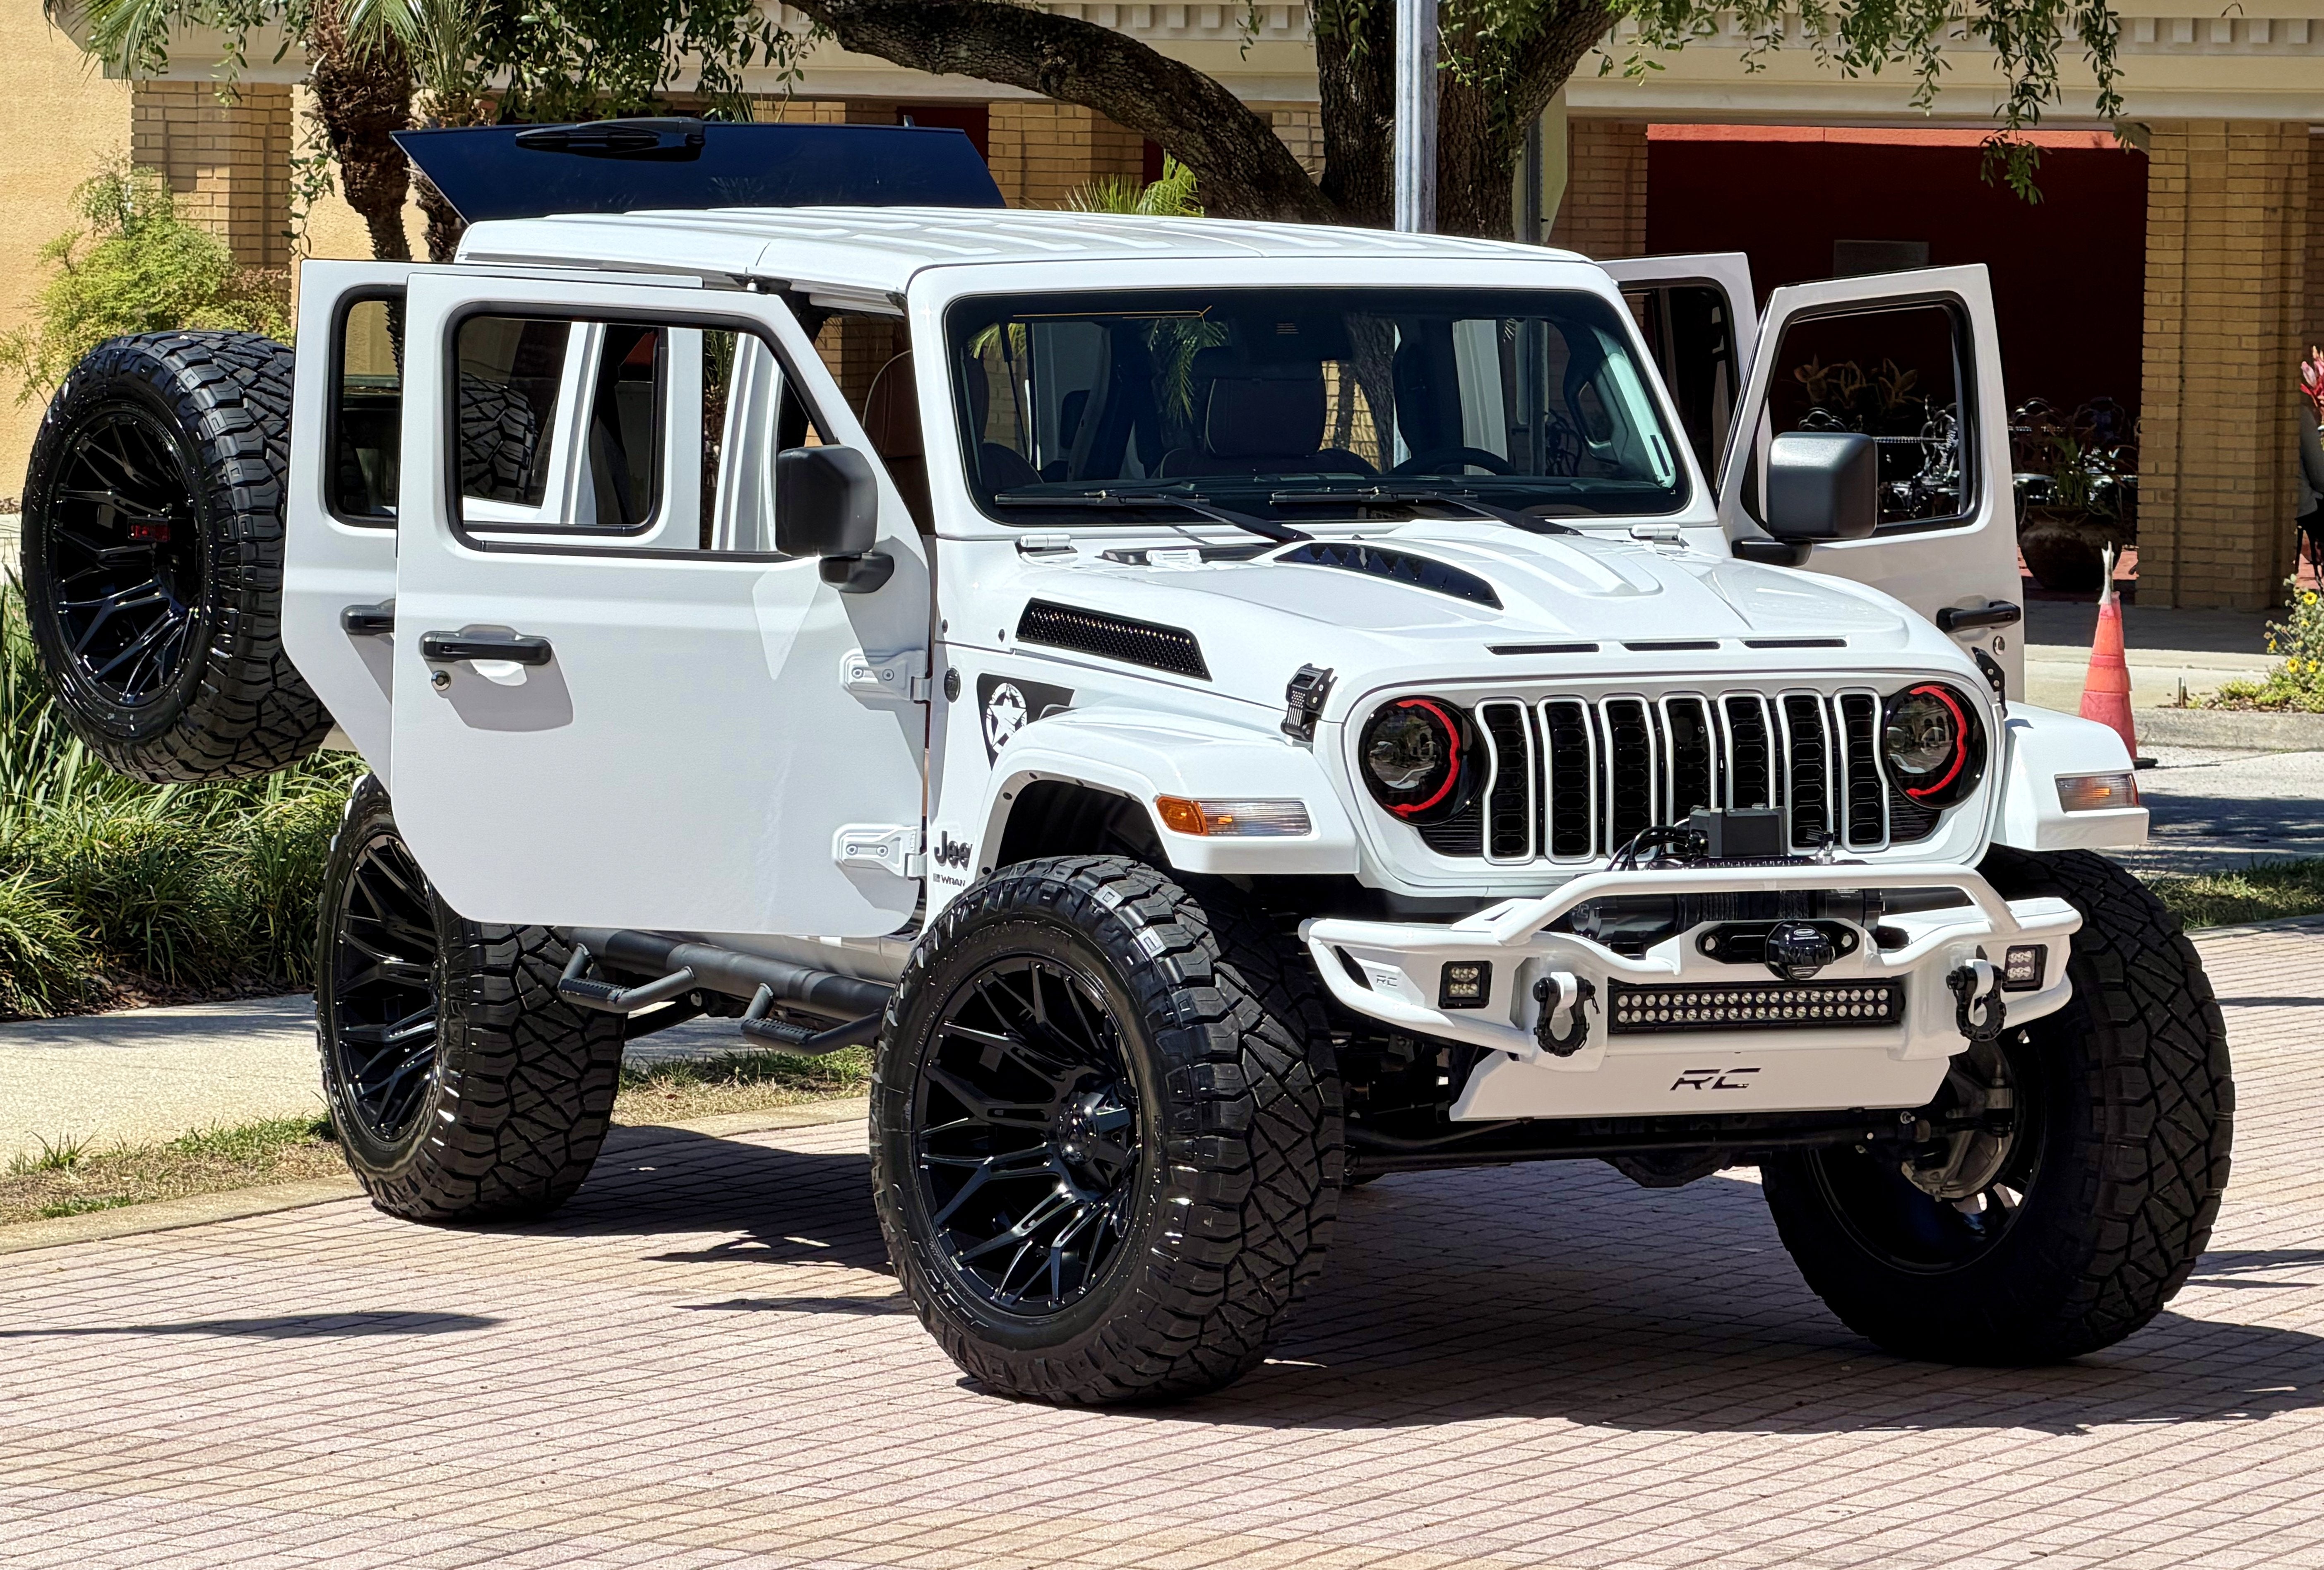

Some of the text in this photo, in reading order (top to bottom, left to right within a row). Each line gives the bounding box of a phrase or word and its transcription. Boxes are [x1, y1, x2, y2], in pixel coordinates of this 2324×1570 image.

[934, 830, 973, 871] Jee
[1376, 975, 1397, 987] RC
[1670, 1068, 1762, 1090] RC
